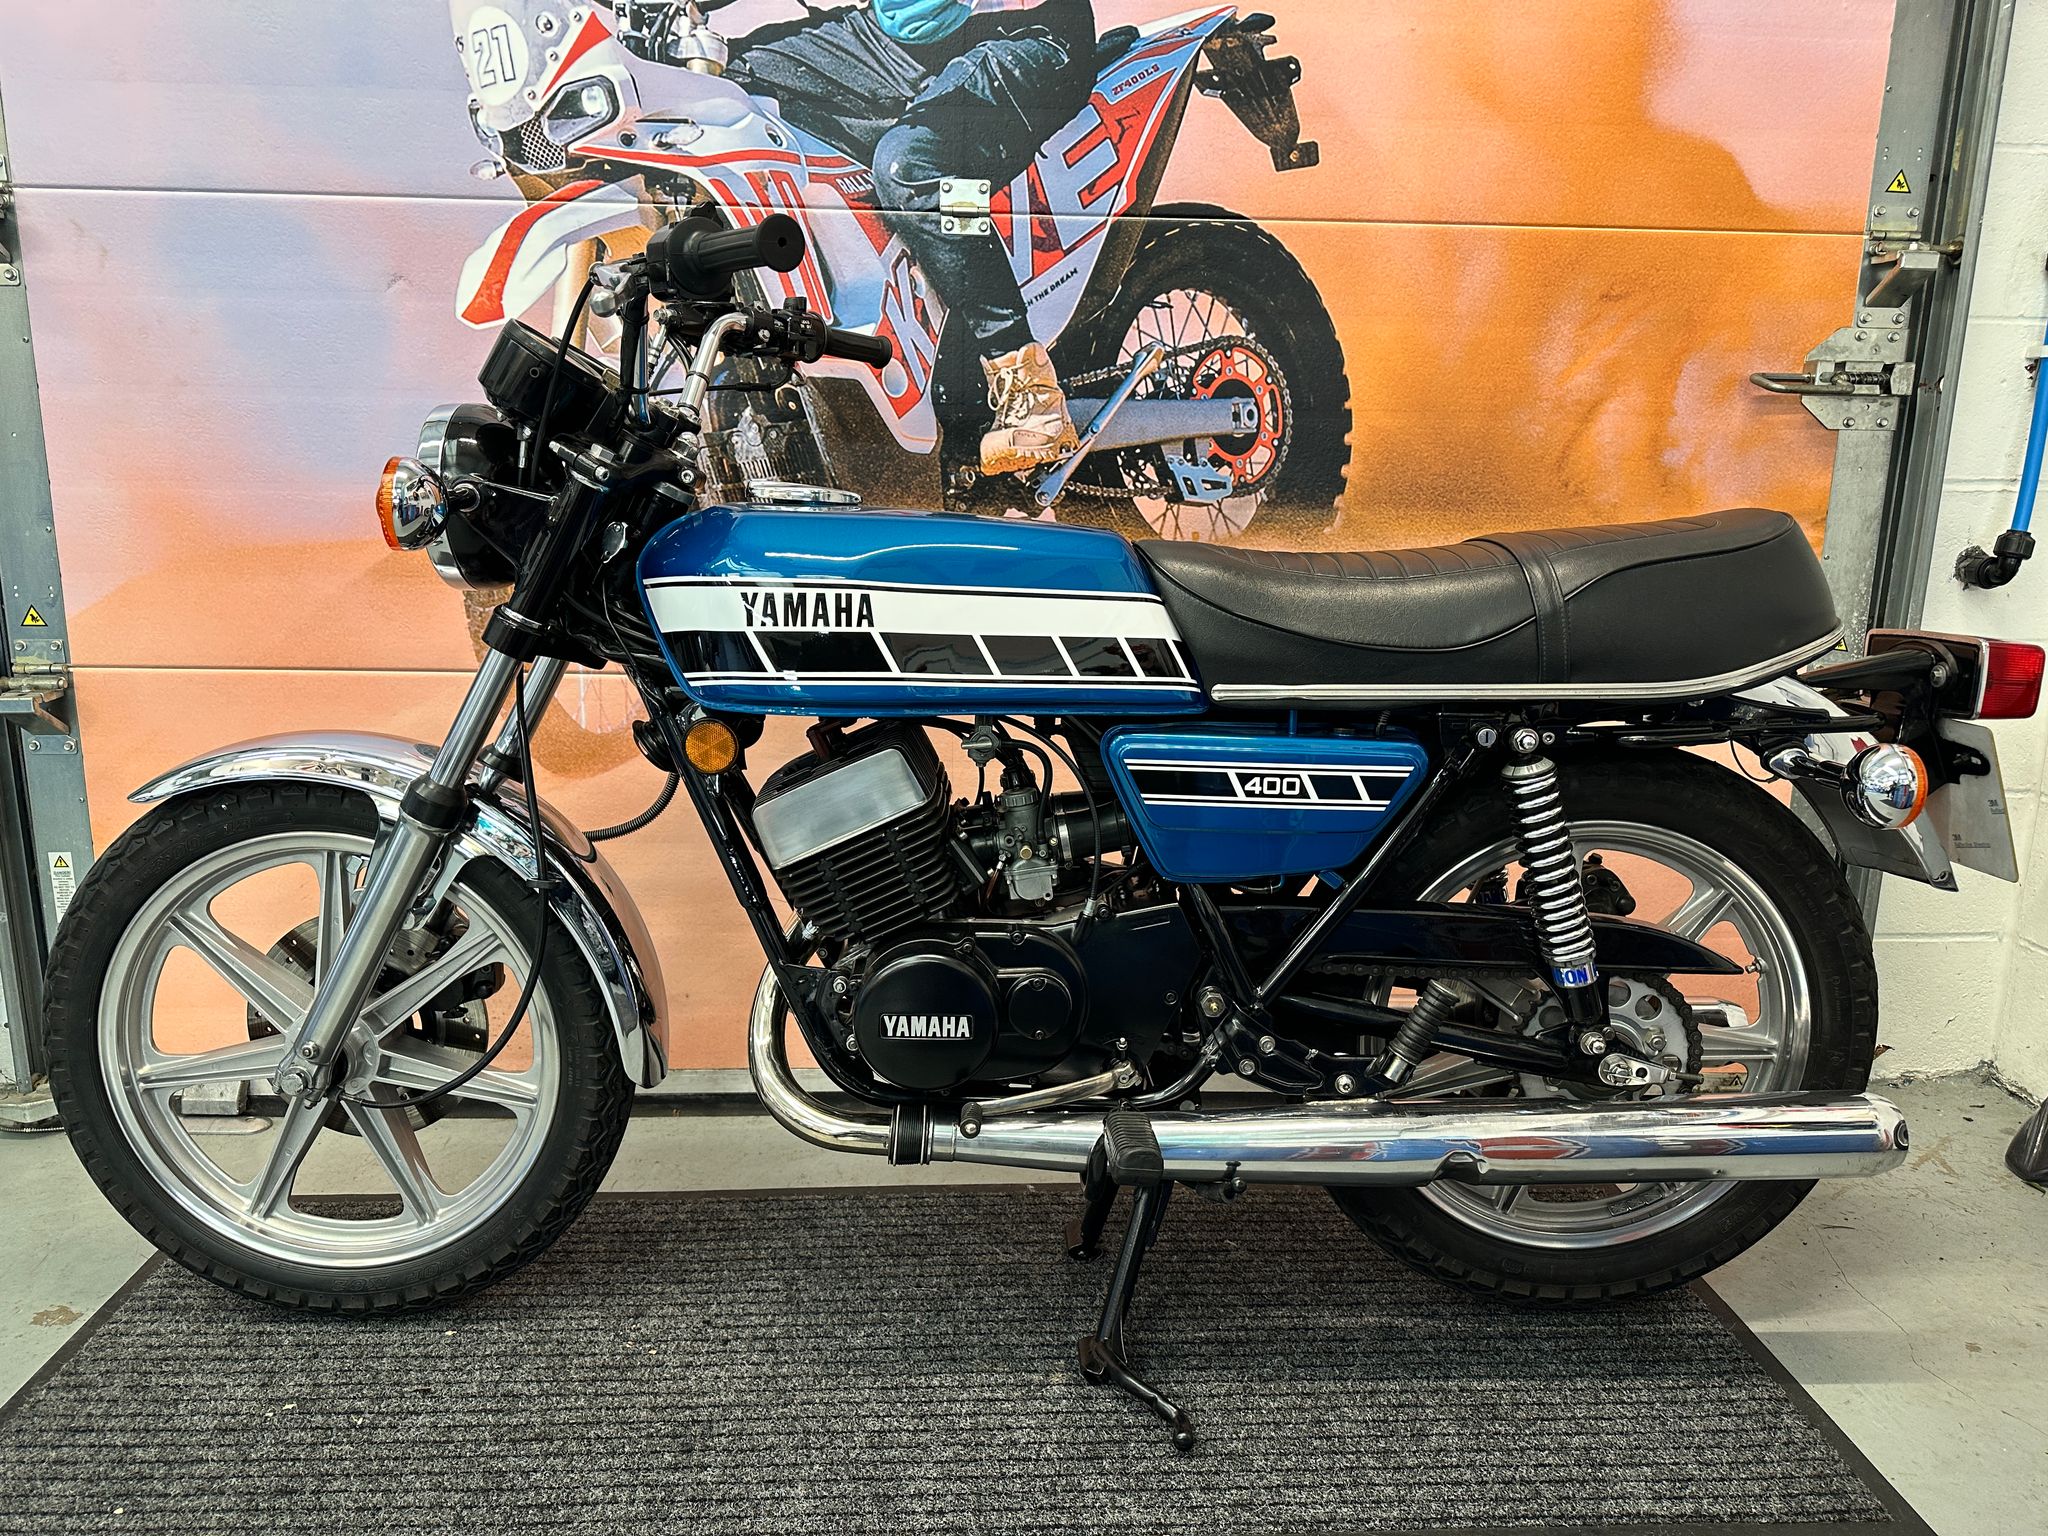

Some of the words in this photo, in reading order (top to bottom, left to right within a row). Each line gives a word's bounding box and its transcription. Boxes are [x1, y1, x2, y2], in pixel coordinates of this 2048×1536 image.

[472, 24, 516, 88] 21
[1034, 288, 1049, 302] THE
[1049, 267, 1078, 292] DREAM
[740, 592, 875, 627] YAMAHA
[1244, 776, 1301, 795] 400
[883, 1015, 970, 1037] YAMAHA
